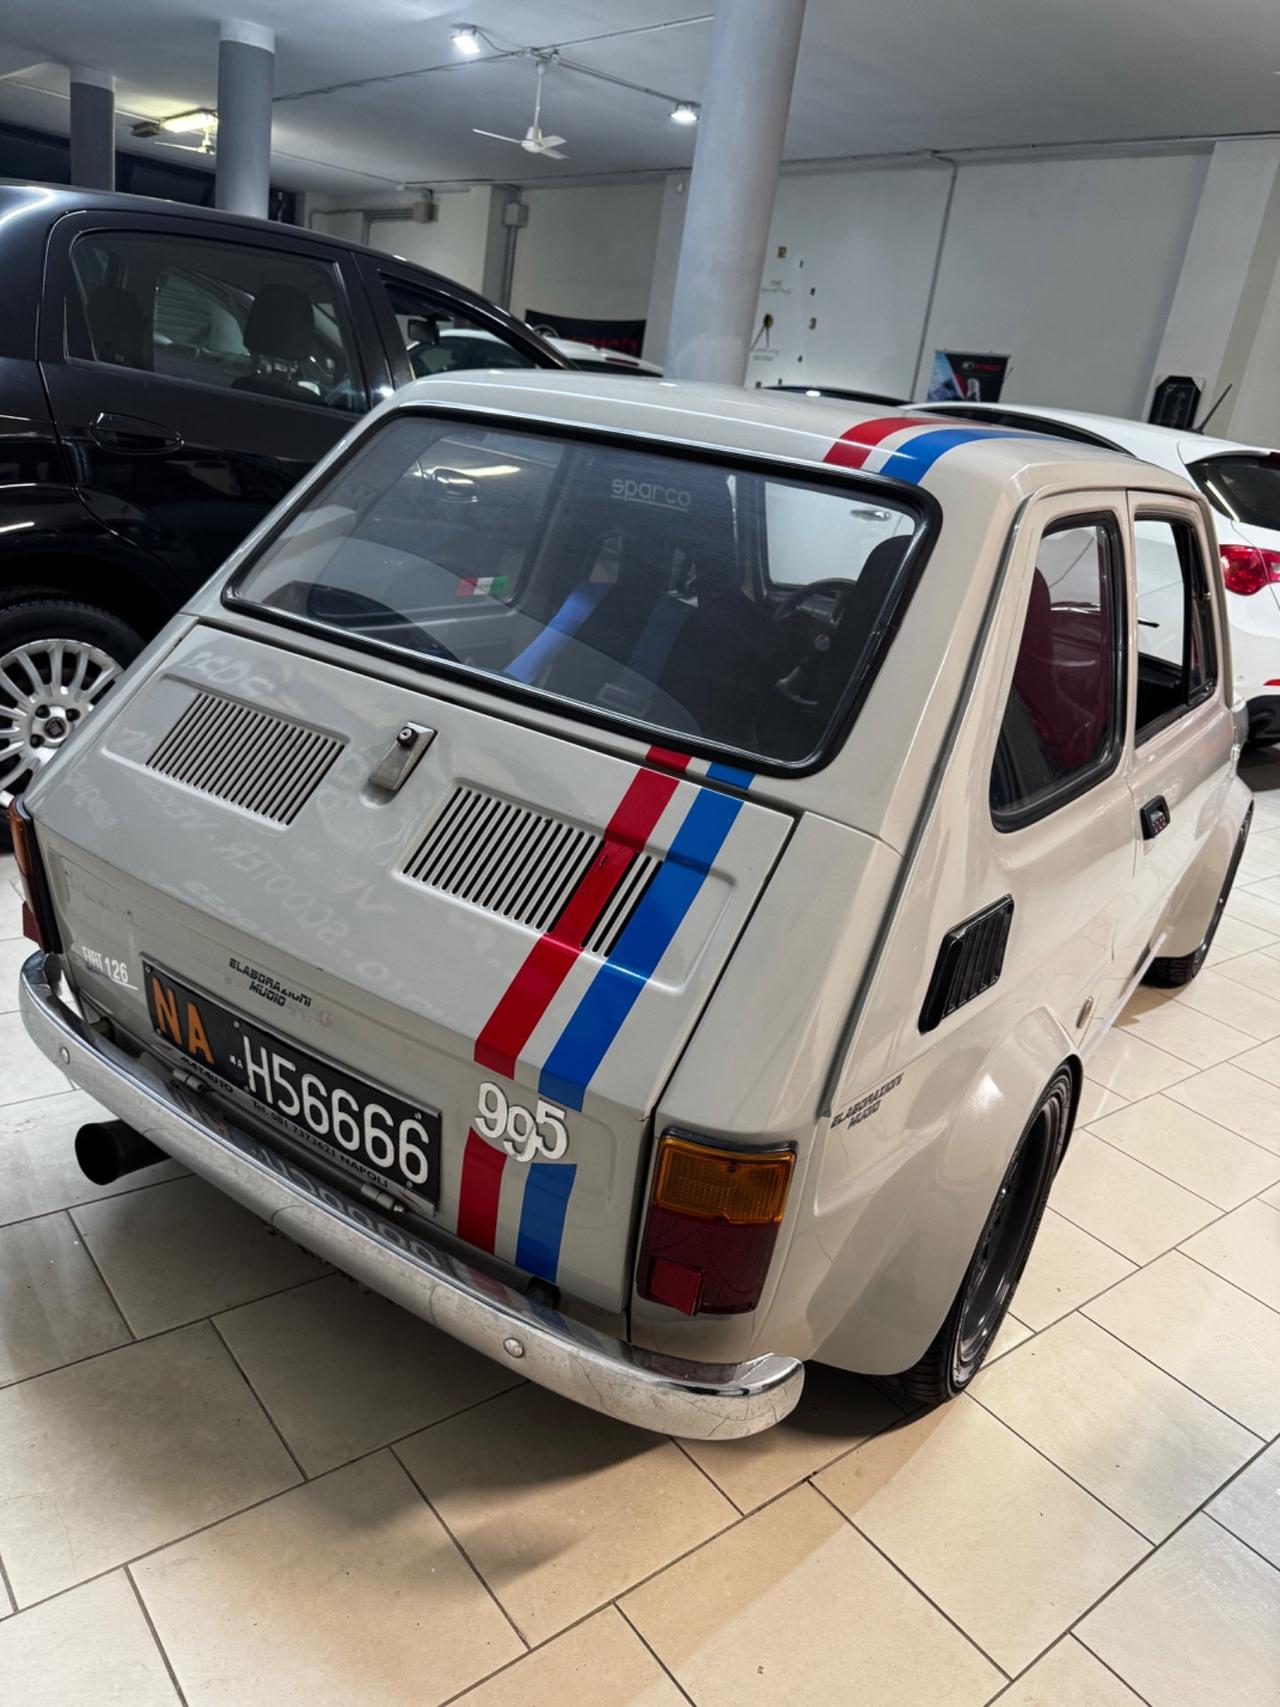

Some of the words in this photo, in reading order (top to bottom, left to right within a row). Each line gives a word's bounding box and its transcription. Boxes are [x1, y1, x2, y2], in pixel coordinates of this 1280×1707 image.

[611, 478, 691, 507] sparco
[104, 957, 129, 983] 126
[151, 975, 215, 1066] NA
[242, 1034, 430, 1186] H56666
[474, 1081, 570, 1163] 995
[340, 1153, 389, 1188] NAPOLI
